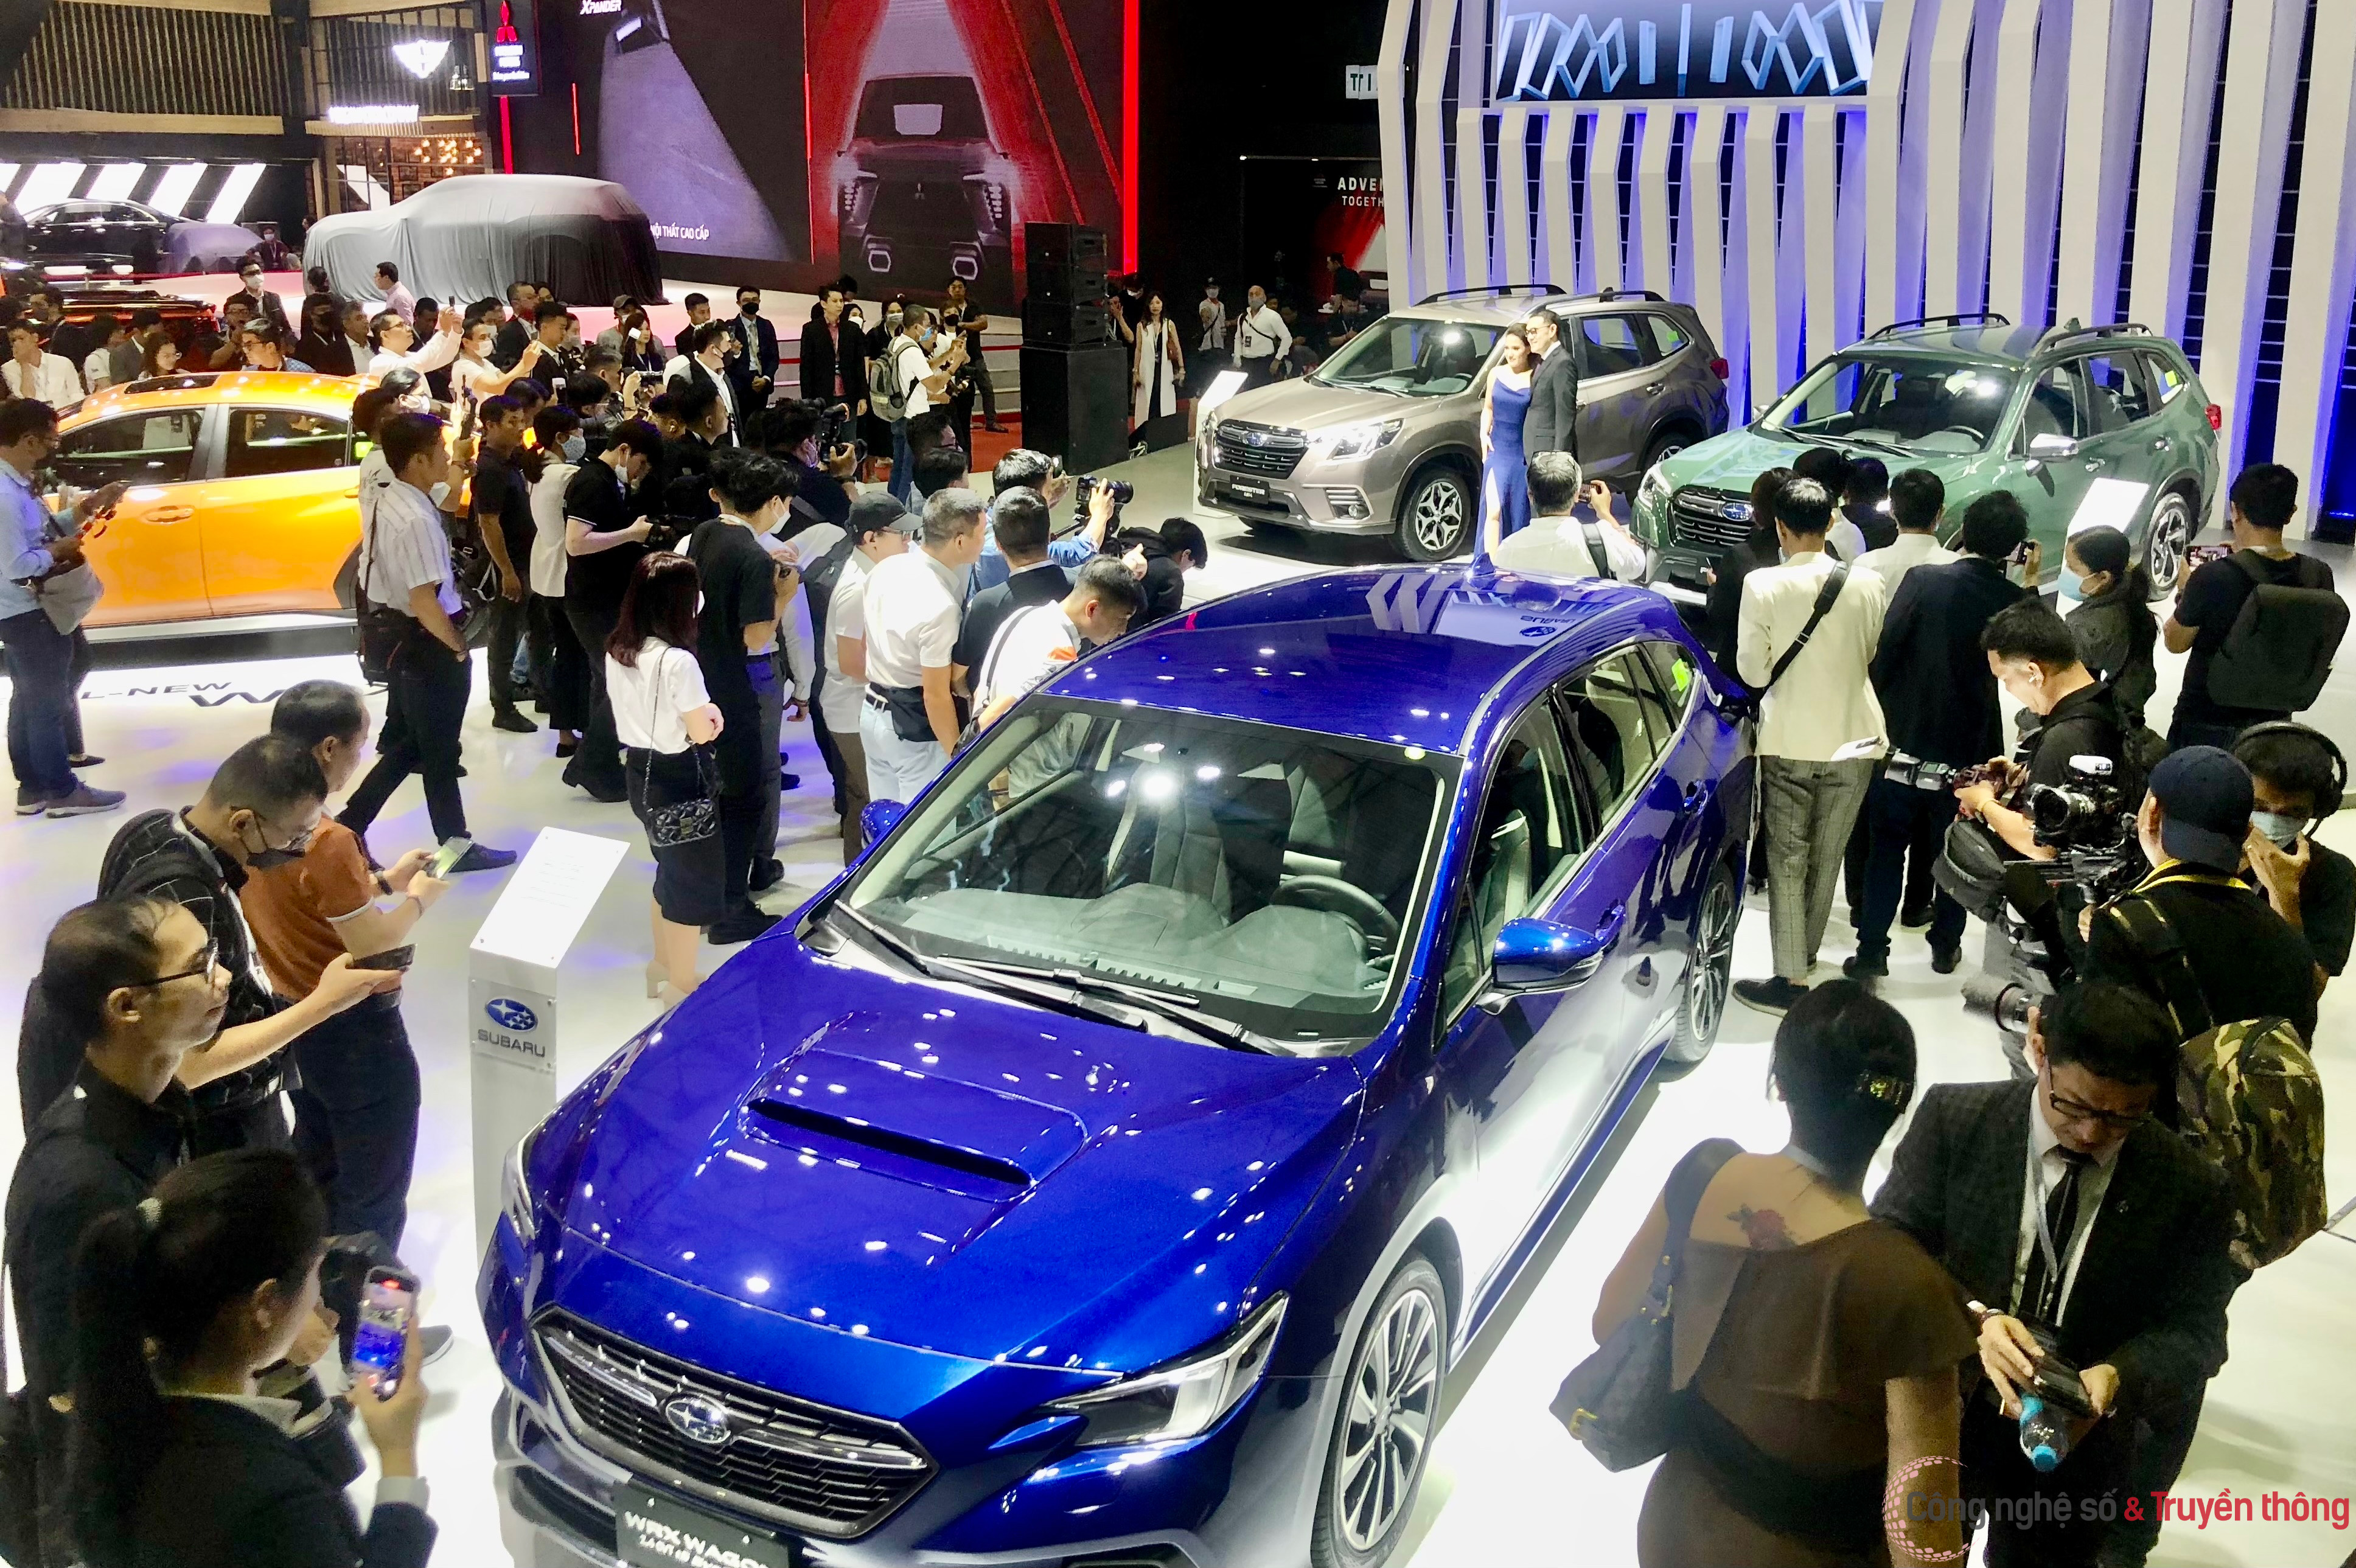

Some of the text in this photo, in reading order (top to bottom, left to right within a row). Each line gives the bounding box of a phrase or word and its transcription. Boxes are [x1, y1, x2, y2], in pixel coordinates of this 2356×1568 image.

[580, 0, 621, 15] XPANDER
[1342, 195, 1384, 207] TOGETH
[662, 222, 680, 238] THẤT
[680, 227, 694, 239] CAO
[695, 224, 709, 240] CẤP
[80, 681, 231, 700] L-NEW
[478, 1029, 546, 1058] SUBARU
[624, 1510, 681, 1546] WRX
[683, 1532, 769, 1568] WAGO
